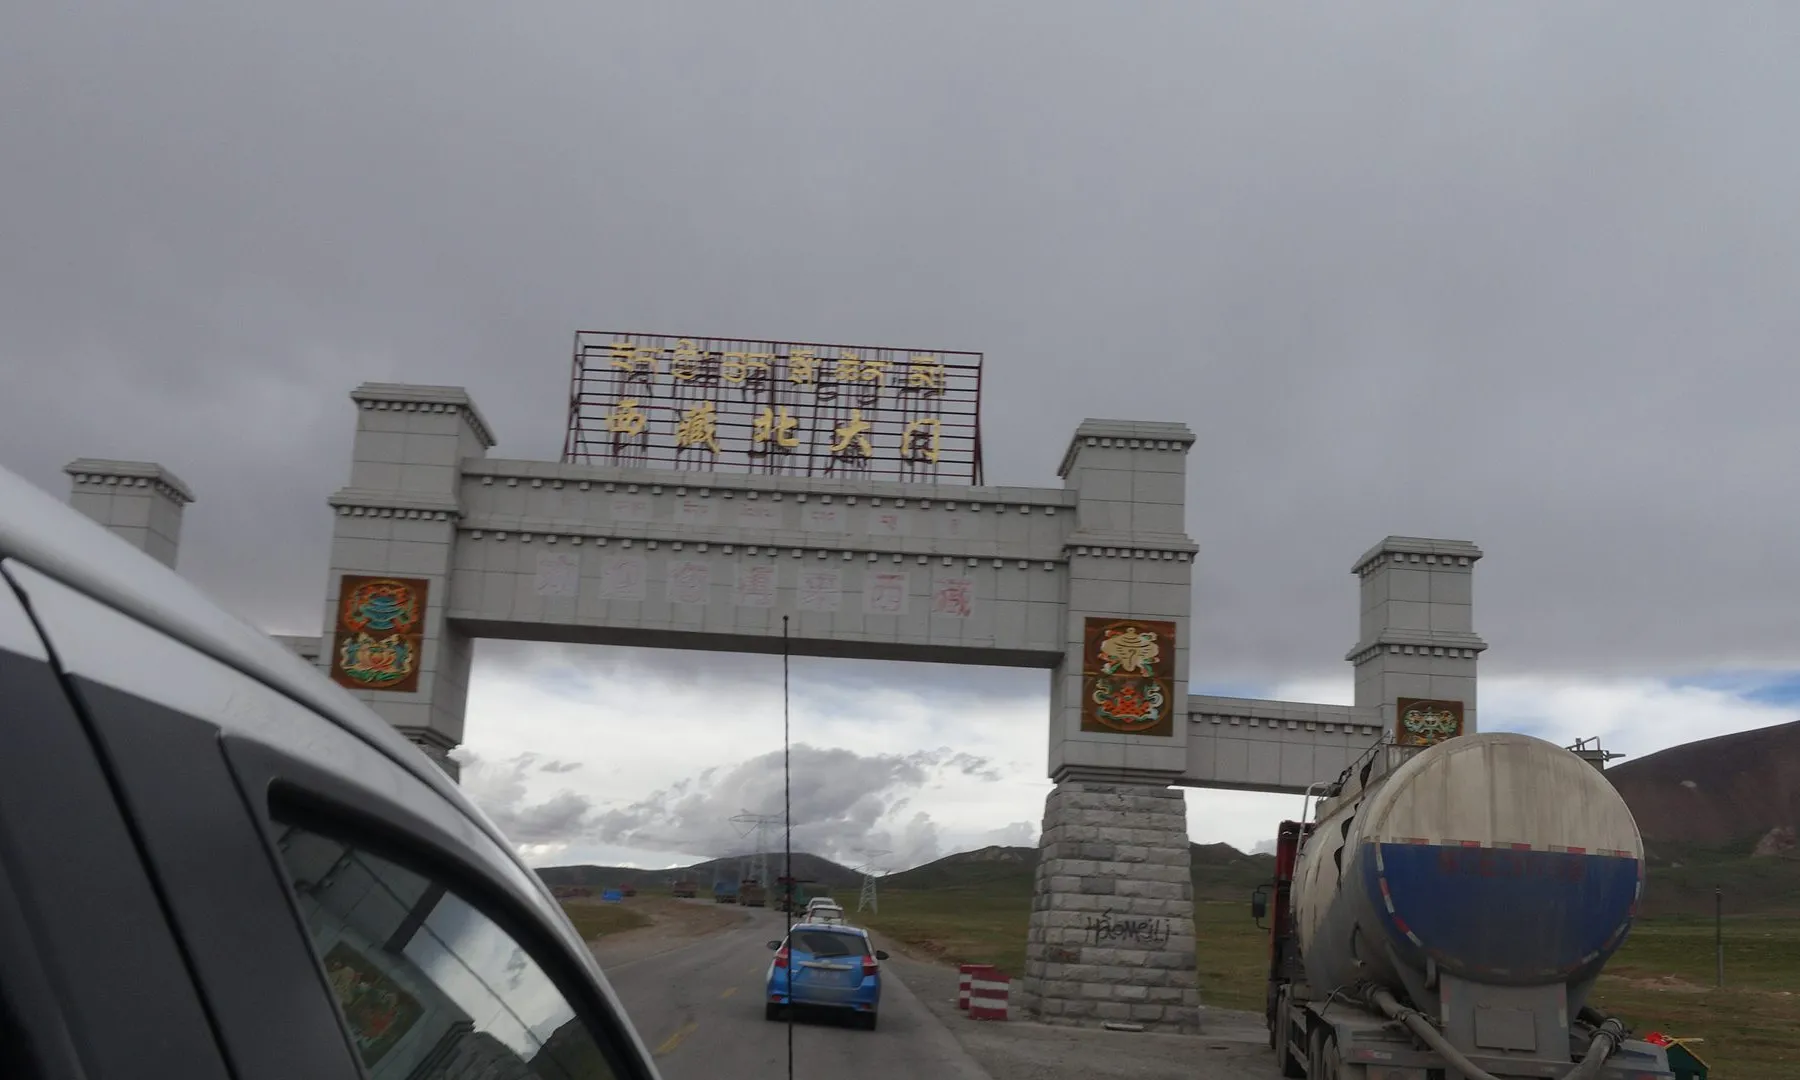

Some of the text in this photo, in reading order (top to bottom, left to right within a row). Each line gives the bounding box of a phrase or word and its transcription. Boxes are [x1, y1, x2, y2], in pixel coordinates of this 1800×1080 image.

[606, 399, 941, 464] 西藏北大门
